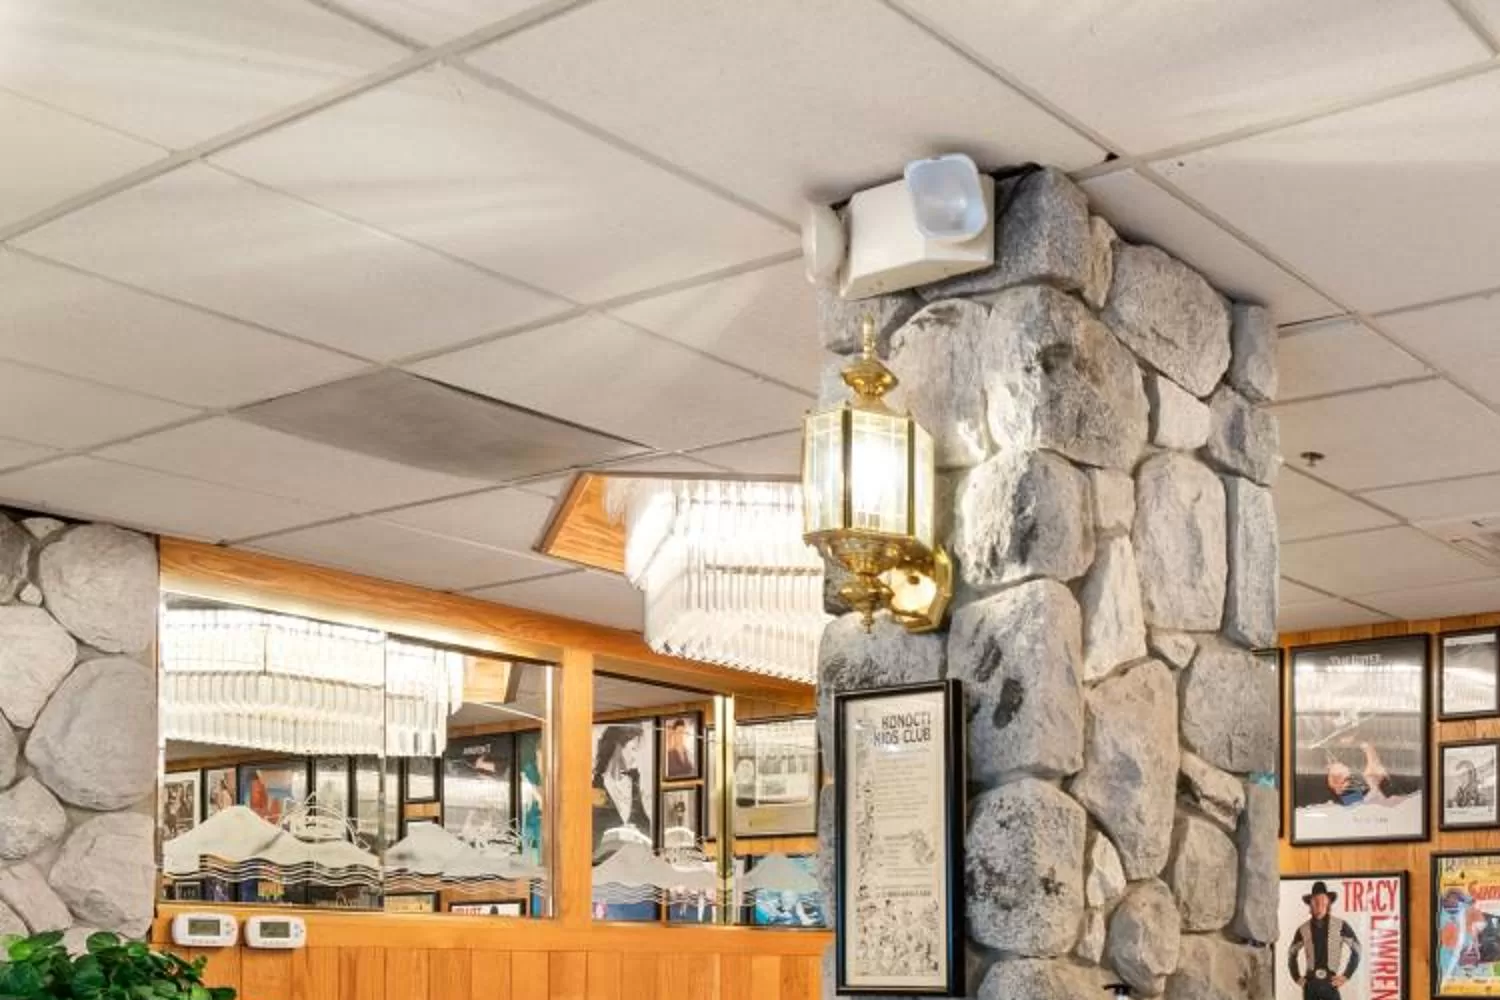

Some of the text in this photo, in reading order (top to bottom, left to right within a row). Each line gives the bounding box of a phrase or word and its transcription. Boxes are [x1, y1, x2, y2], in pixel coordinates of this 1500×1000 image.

[881, 711, 931, 730] KONOCTI
[903, 727, 931, 743] CLUB
[1343, 879, 1399, 913] TRACY
